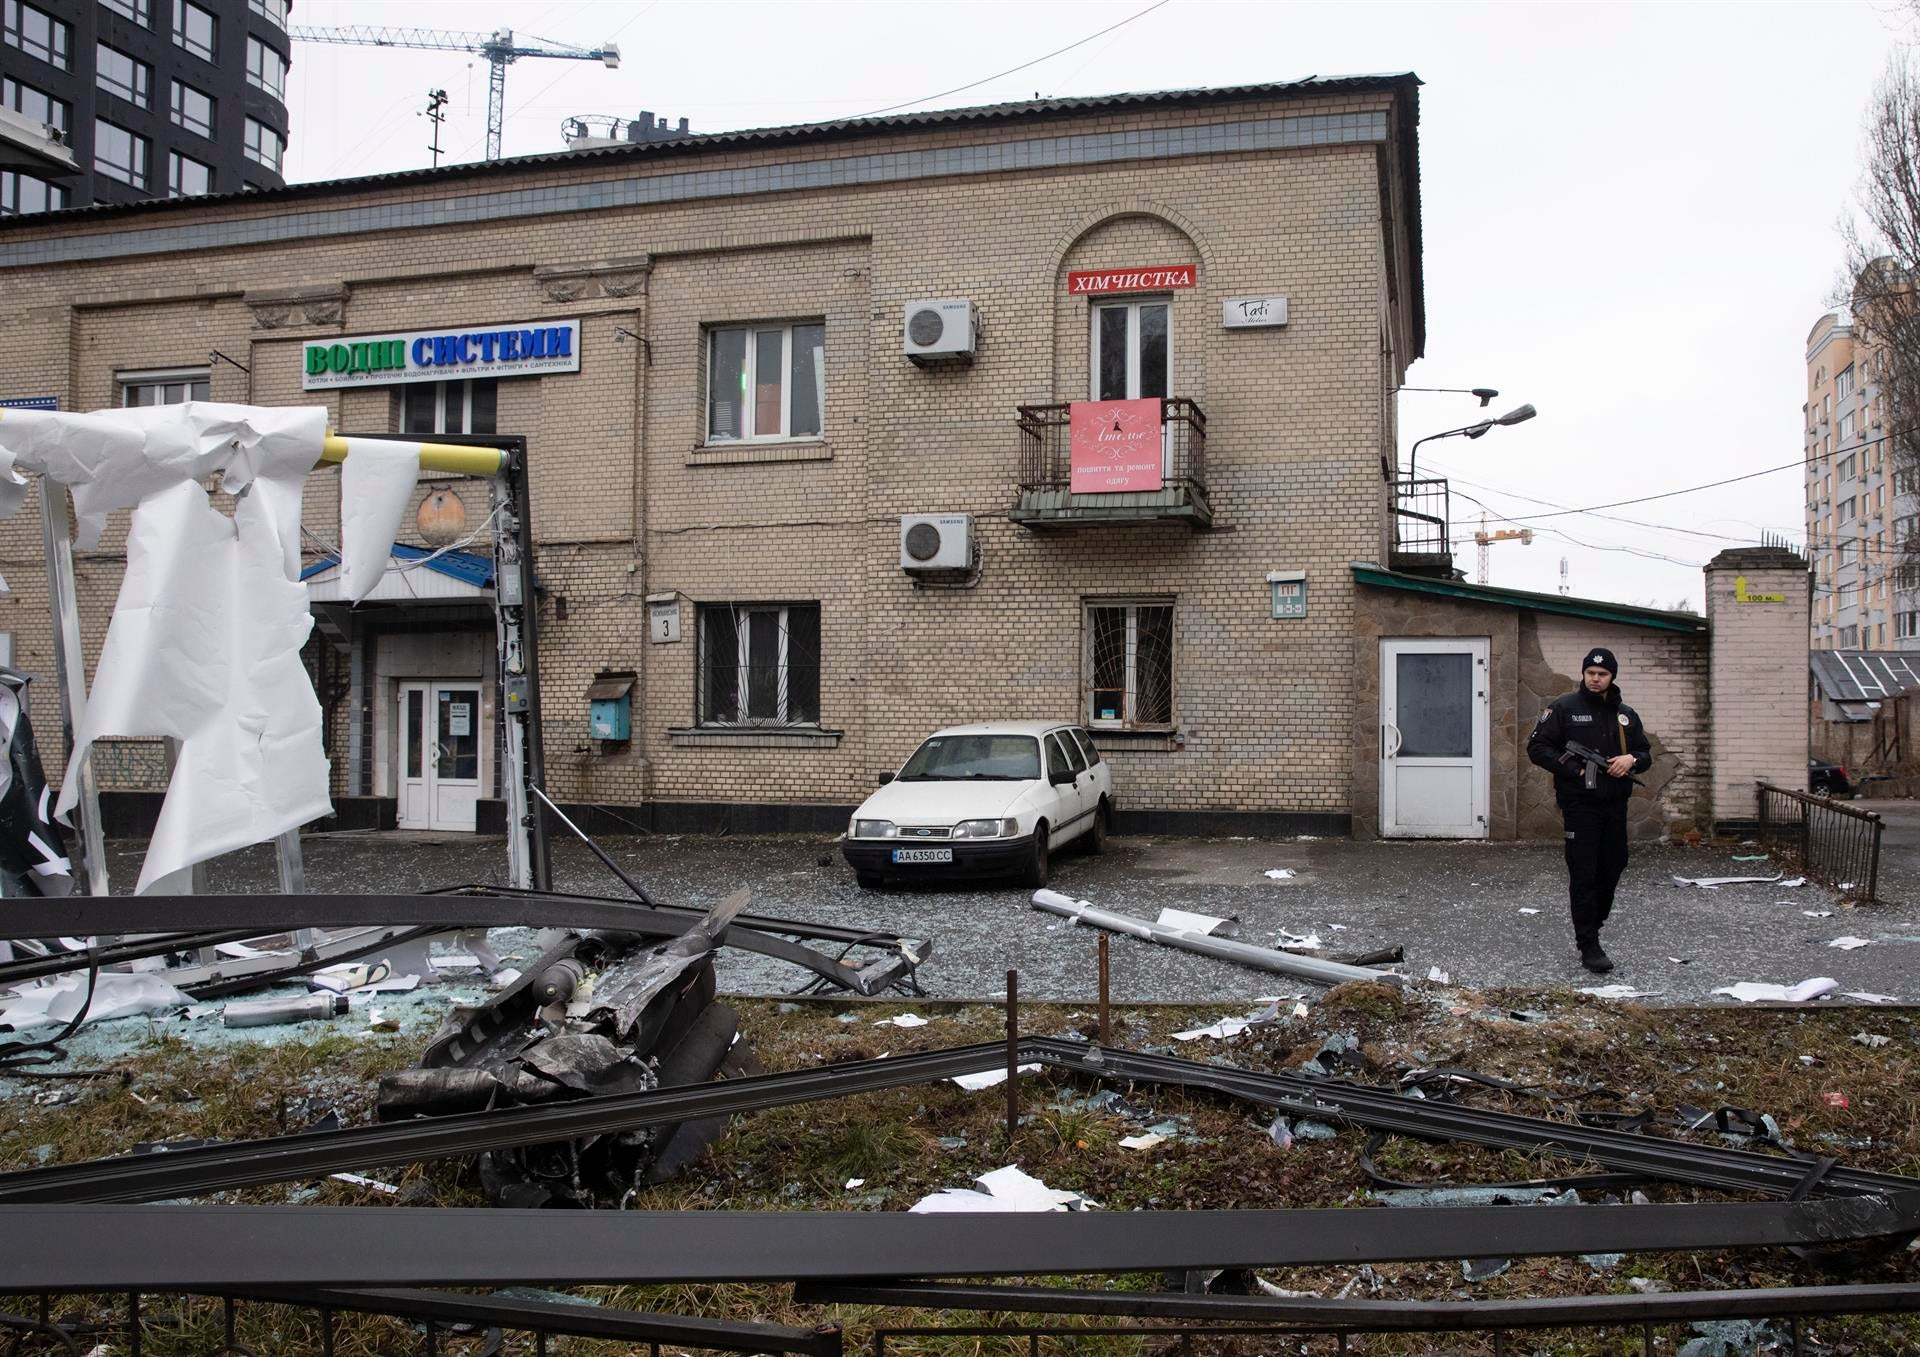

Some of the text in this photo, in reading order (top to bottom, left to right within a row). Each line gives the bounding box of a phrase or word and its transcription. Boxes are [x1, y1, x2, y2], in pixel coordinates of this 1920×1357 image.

[1074, 271, 1190, 291] ХІМЧИСТКА
[1239, 300, 1269, 317] Tati
[305, 326, 572, 375] ВОДНІ СИСТЕМИ
[461, 366, 490, 374] ФІЛЬТРИ
[530, 360, 573, 369] САНТЕХНІКА
[1077, 466, 1112, 474] пошиття
[1126, 463, 1156, 473] ремонт
[1106, 477, 1130, 485] одягу
[662, 619, 670, 637] 3
[898, 850, 951, 862] AA 6350 CC
